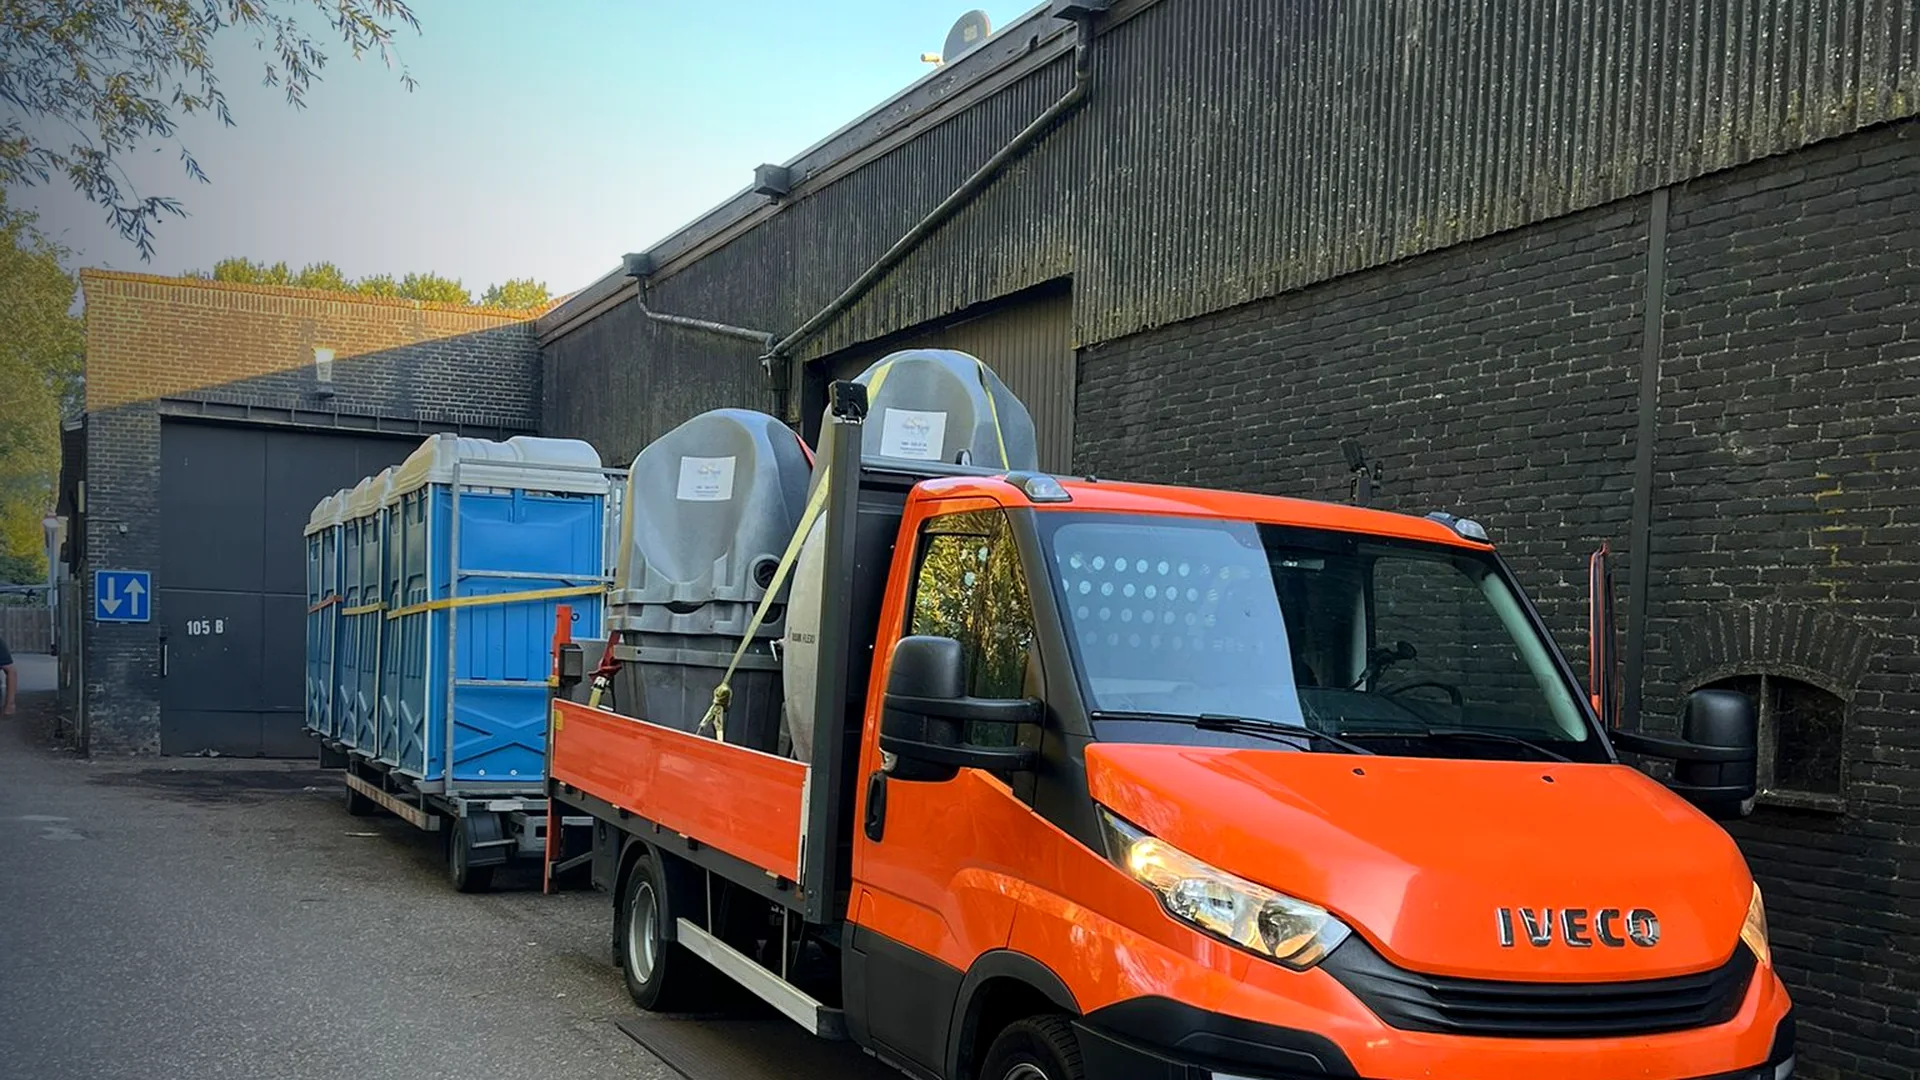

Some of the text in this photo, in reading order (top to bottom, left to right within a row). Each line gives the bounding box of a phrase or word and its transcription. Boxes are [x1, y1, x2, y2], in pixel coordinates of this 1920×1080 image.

[186, 619, 224, 636] 105 B
[1496, 907, 1661, 948] IVECO
